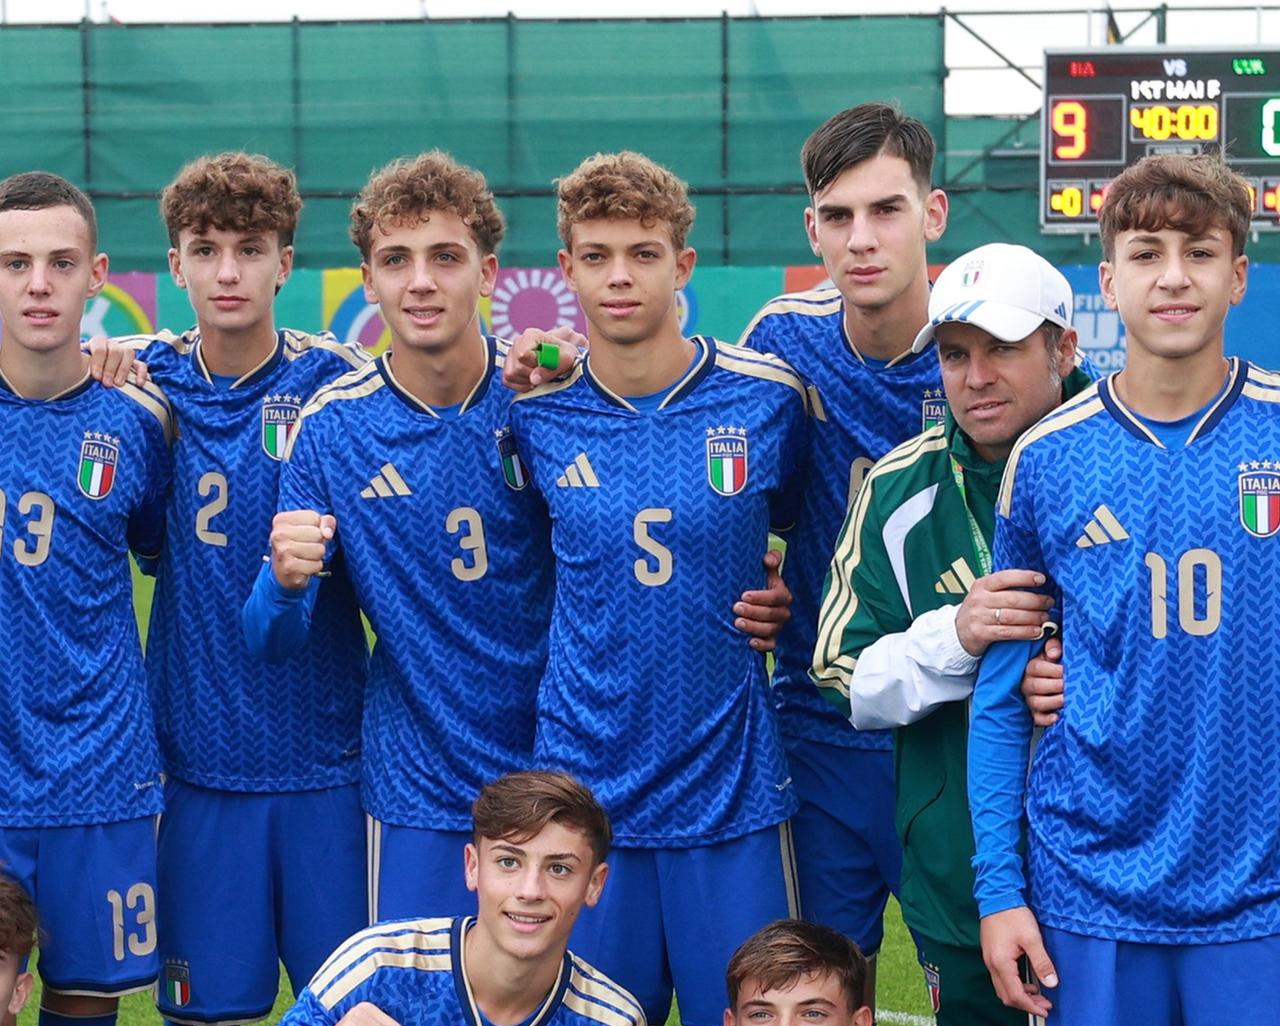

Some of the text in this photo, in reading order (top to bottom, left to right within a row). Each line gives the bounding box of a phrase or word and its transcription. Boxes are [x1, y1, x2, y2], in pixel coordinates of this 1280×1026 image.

[1163, 59, 1187, 77] VS
[1053, 101, 1087, 159] 9
[1130, 105, 1218, 141] 40:00
[265, 409, 297, 420] ITALIA
[84, 444, 114, 461] ITALIA
[710, 442, 744, 453] ITALIA
[1243, 478, 1280, 490] ITALIA
[196, 472, 228, 547] 2
[445, 507, 488, 581] 3
[634, 507, 672, 586] 5
[1144, 548, 1222, 639] 10
[107, 882, 157, 961] 13
